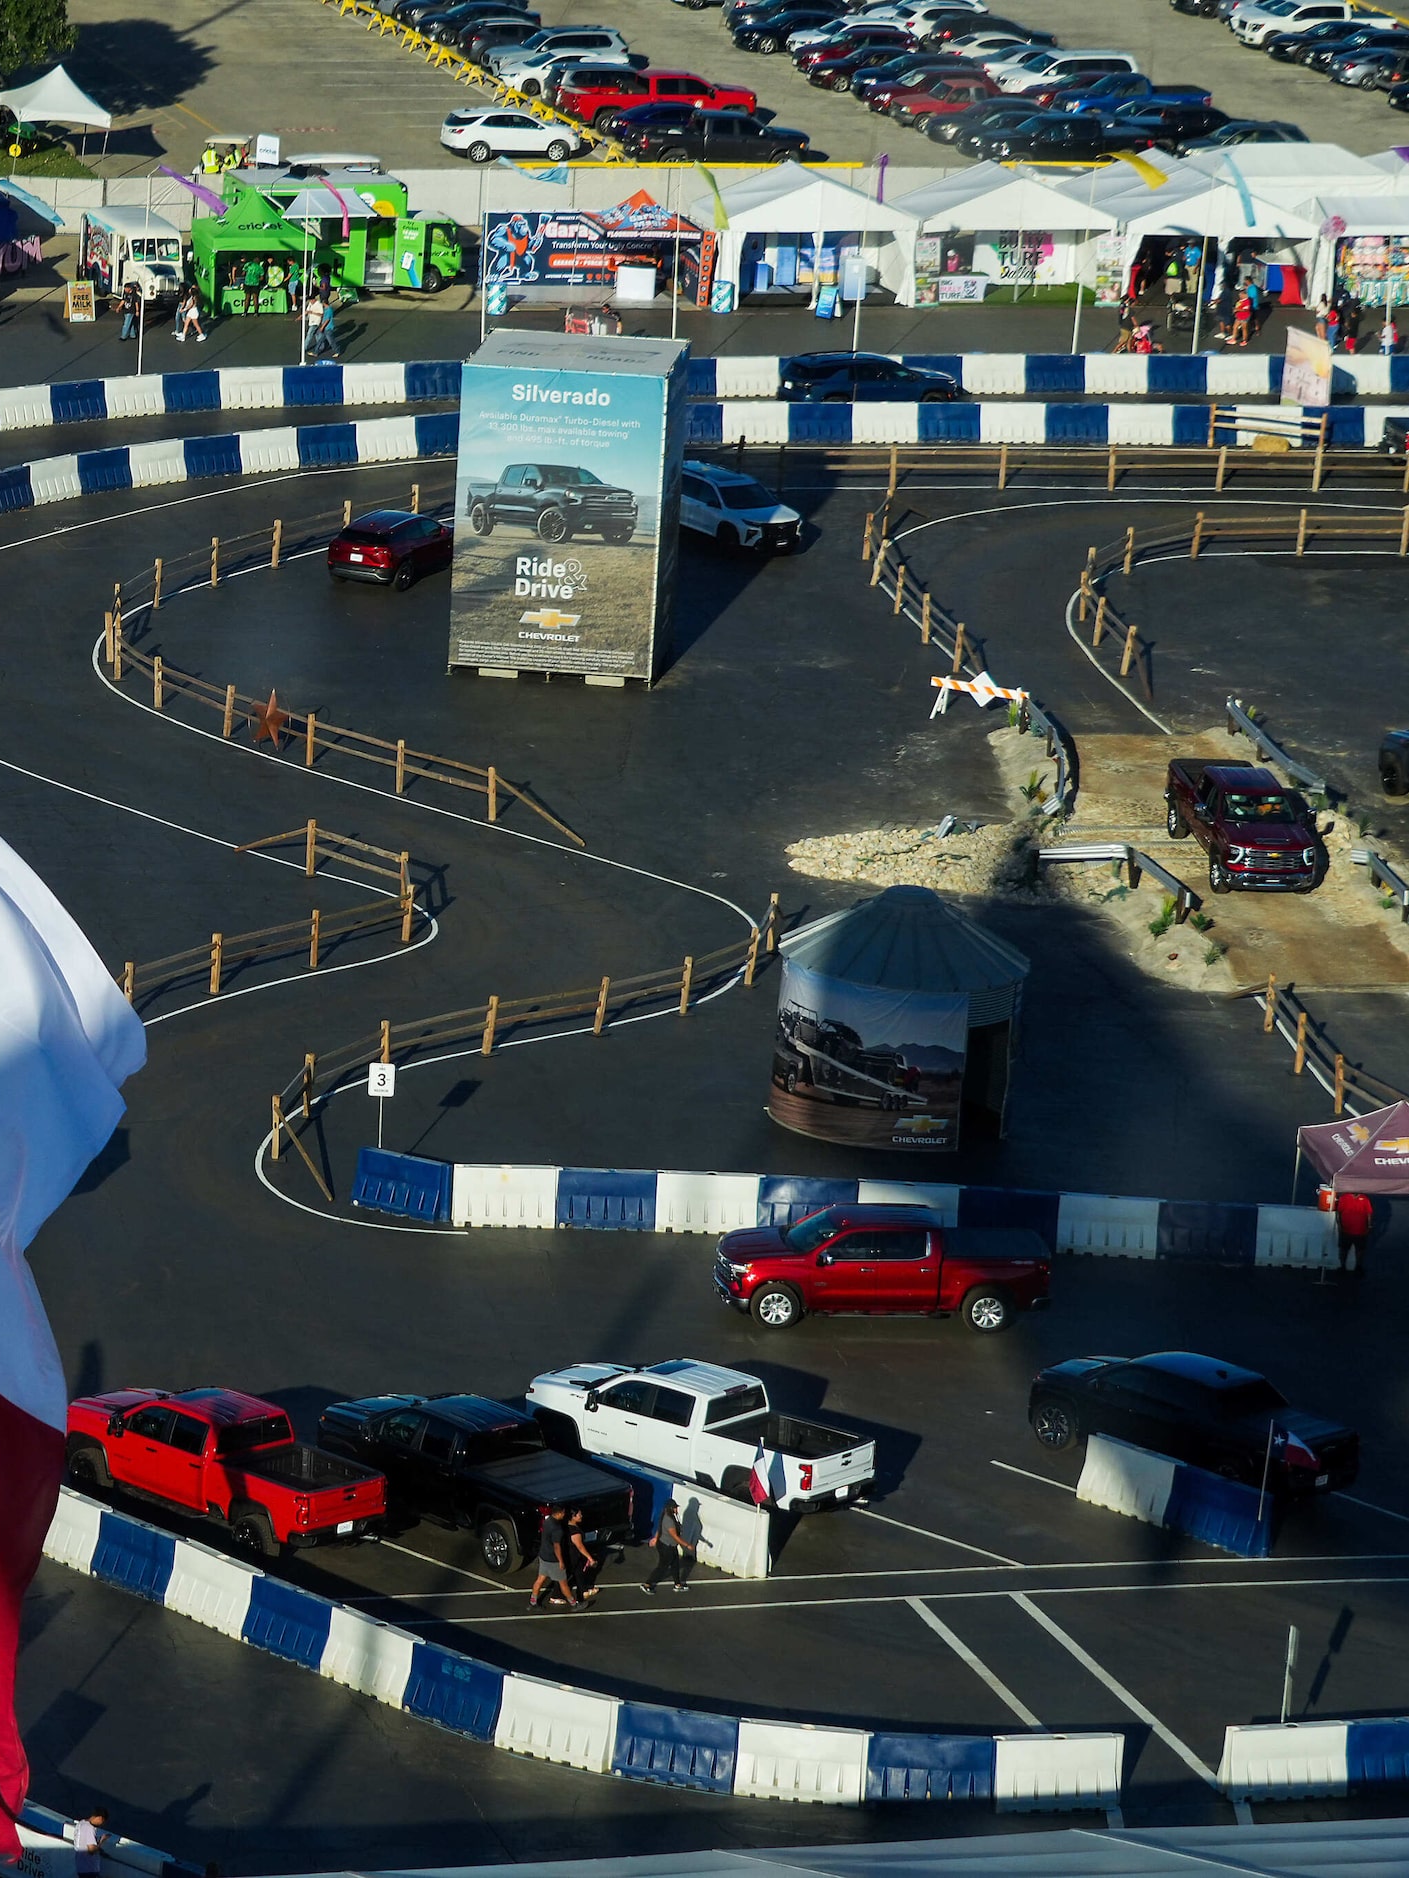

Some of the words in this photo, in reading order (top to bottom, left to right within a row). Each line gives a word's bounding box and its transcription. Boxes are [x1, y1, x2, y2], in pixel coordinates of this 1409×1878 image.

[552, 241, 590, 250] Transform
[72, 301, 92, 309] MILK
[511, 383, 612, 407] Silverado
[479, 411, 518, 421] Available
[564, 416, 620, 427] Turbo-Diesel
[621, 419, 641, 429] with
[557, 426, 596, 436] available
[581, 438, 610, 450] torque
[515, 557, 566, 578] Ride
[515, 578, 574, 600] Drive
[518, 631, 582, 643] CHEVROLET
[377, 1073, 387, 1087] 3
[891, 1134, 948, 1145] CHEVROLET
